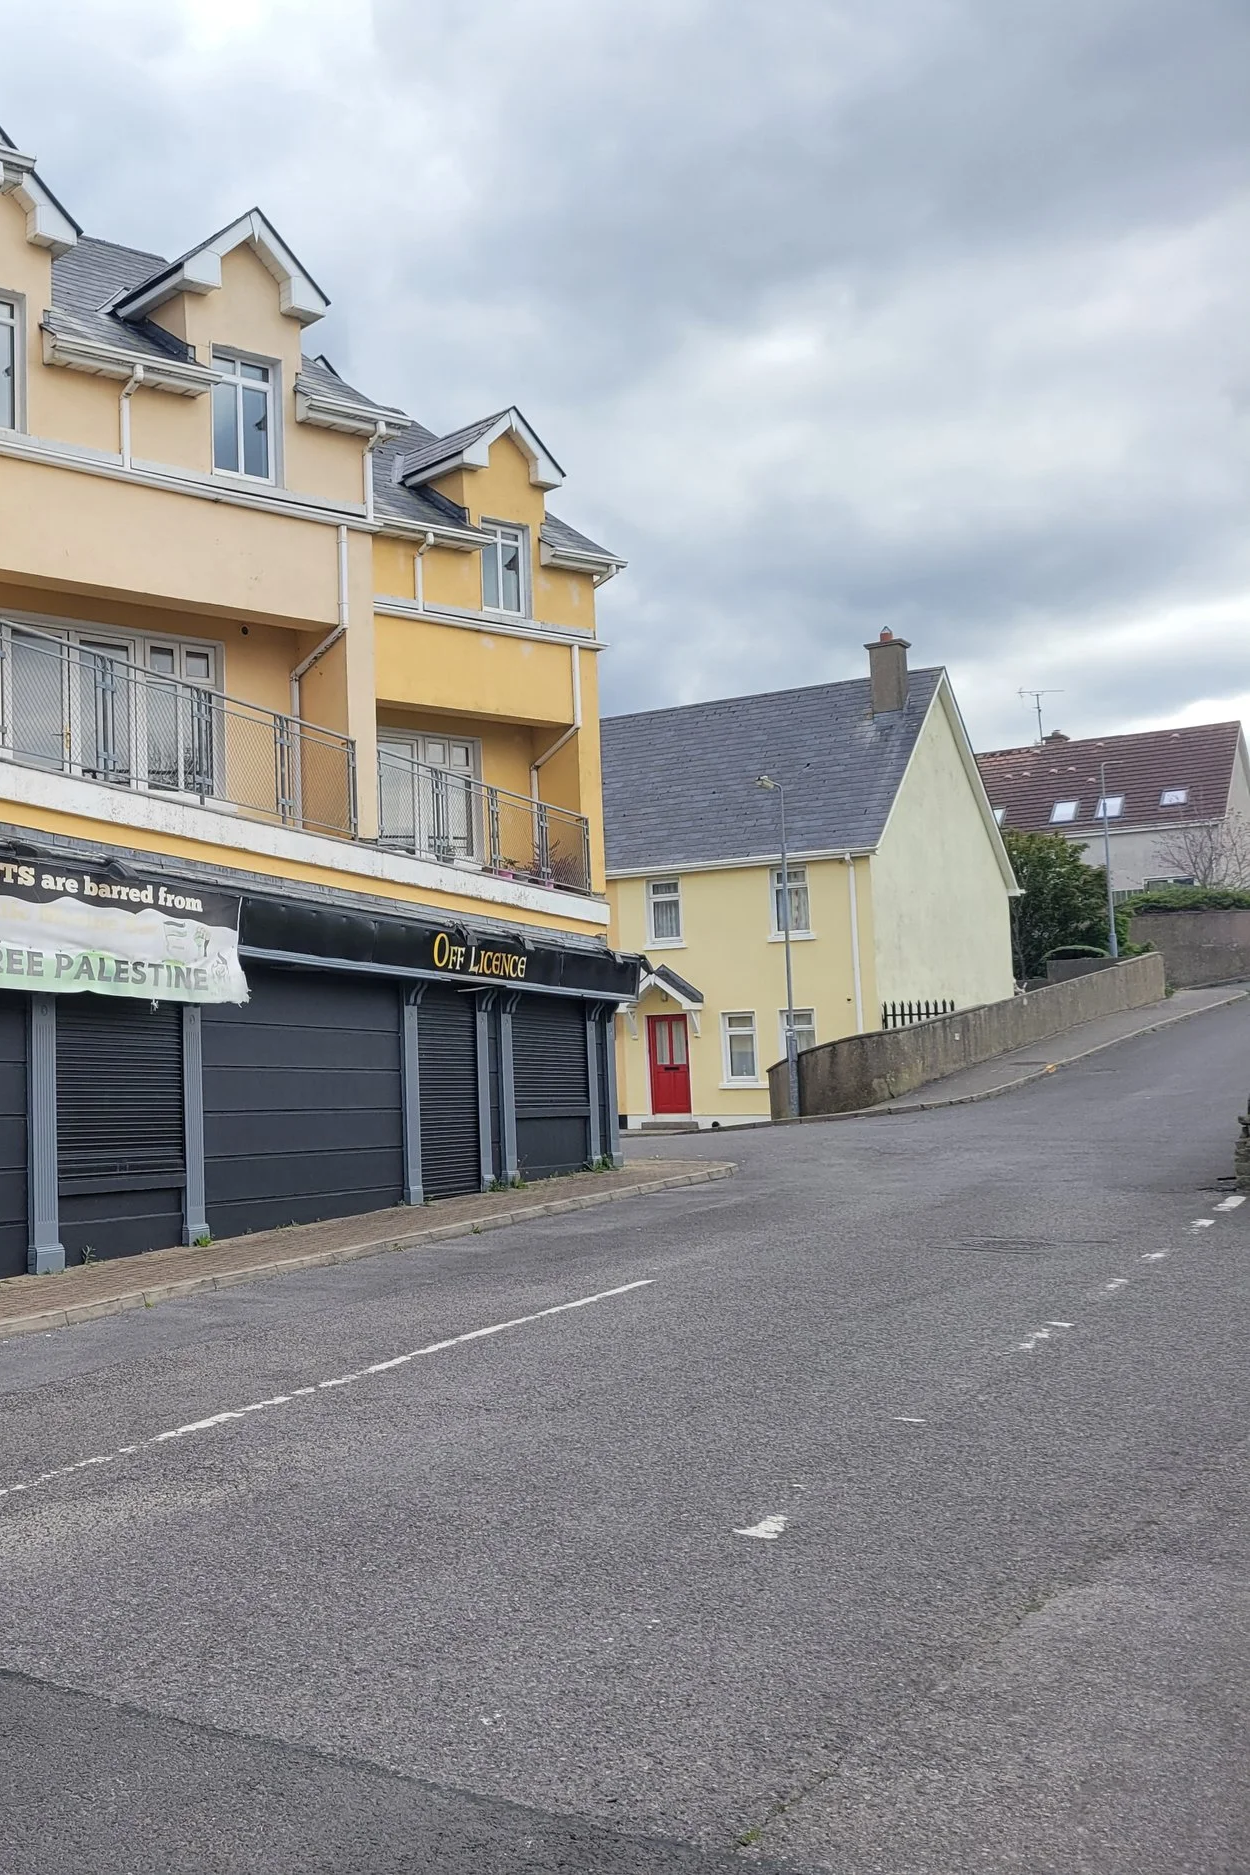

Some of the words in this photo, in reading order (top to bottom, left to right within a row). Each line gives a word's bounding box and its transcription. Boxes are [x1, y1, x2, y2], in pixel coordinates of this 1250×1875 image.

[41, 874, 78, 894] are
[83, 876, 154, 904] barred
[158, 884, 203, 912] from
[54, 953, 209, 991] PALESTINE
[433, 933, 466, 970] OFF
[468, 946, 527, 979] LICENCE
